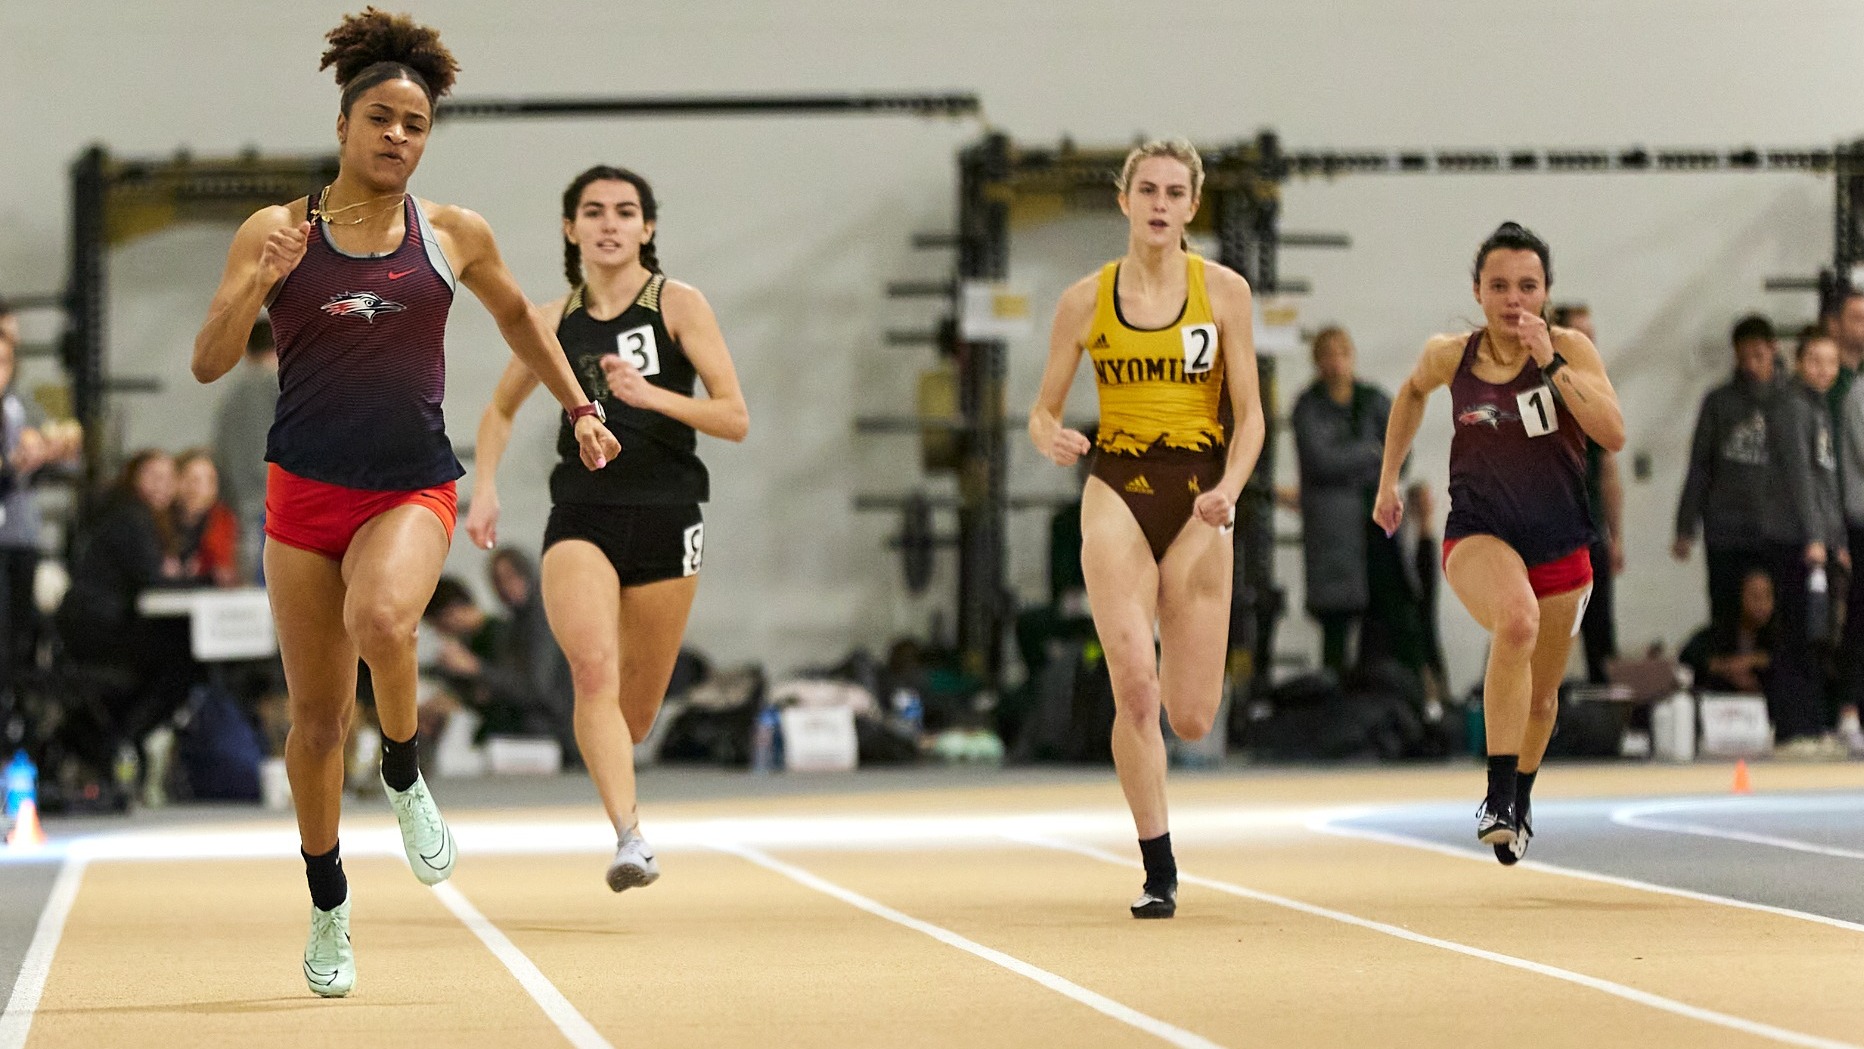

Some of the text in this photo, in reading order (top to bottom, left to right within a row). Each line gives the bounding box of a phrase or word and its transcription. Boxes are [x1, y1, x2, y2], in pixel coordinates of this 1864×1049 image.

[627, 332, 650, 371] 3
[1191, 328, 1210, 370] 2
[1529, 392, 1549, 431] 1
